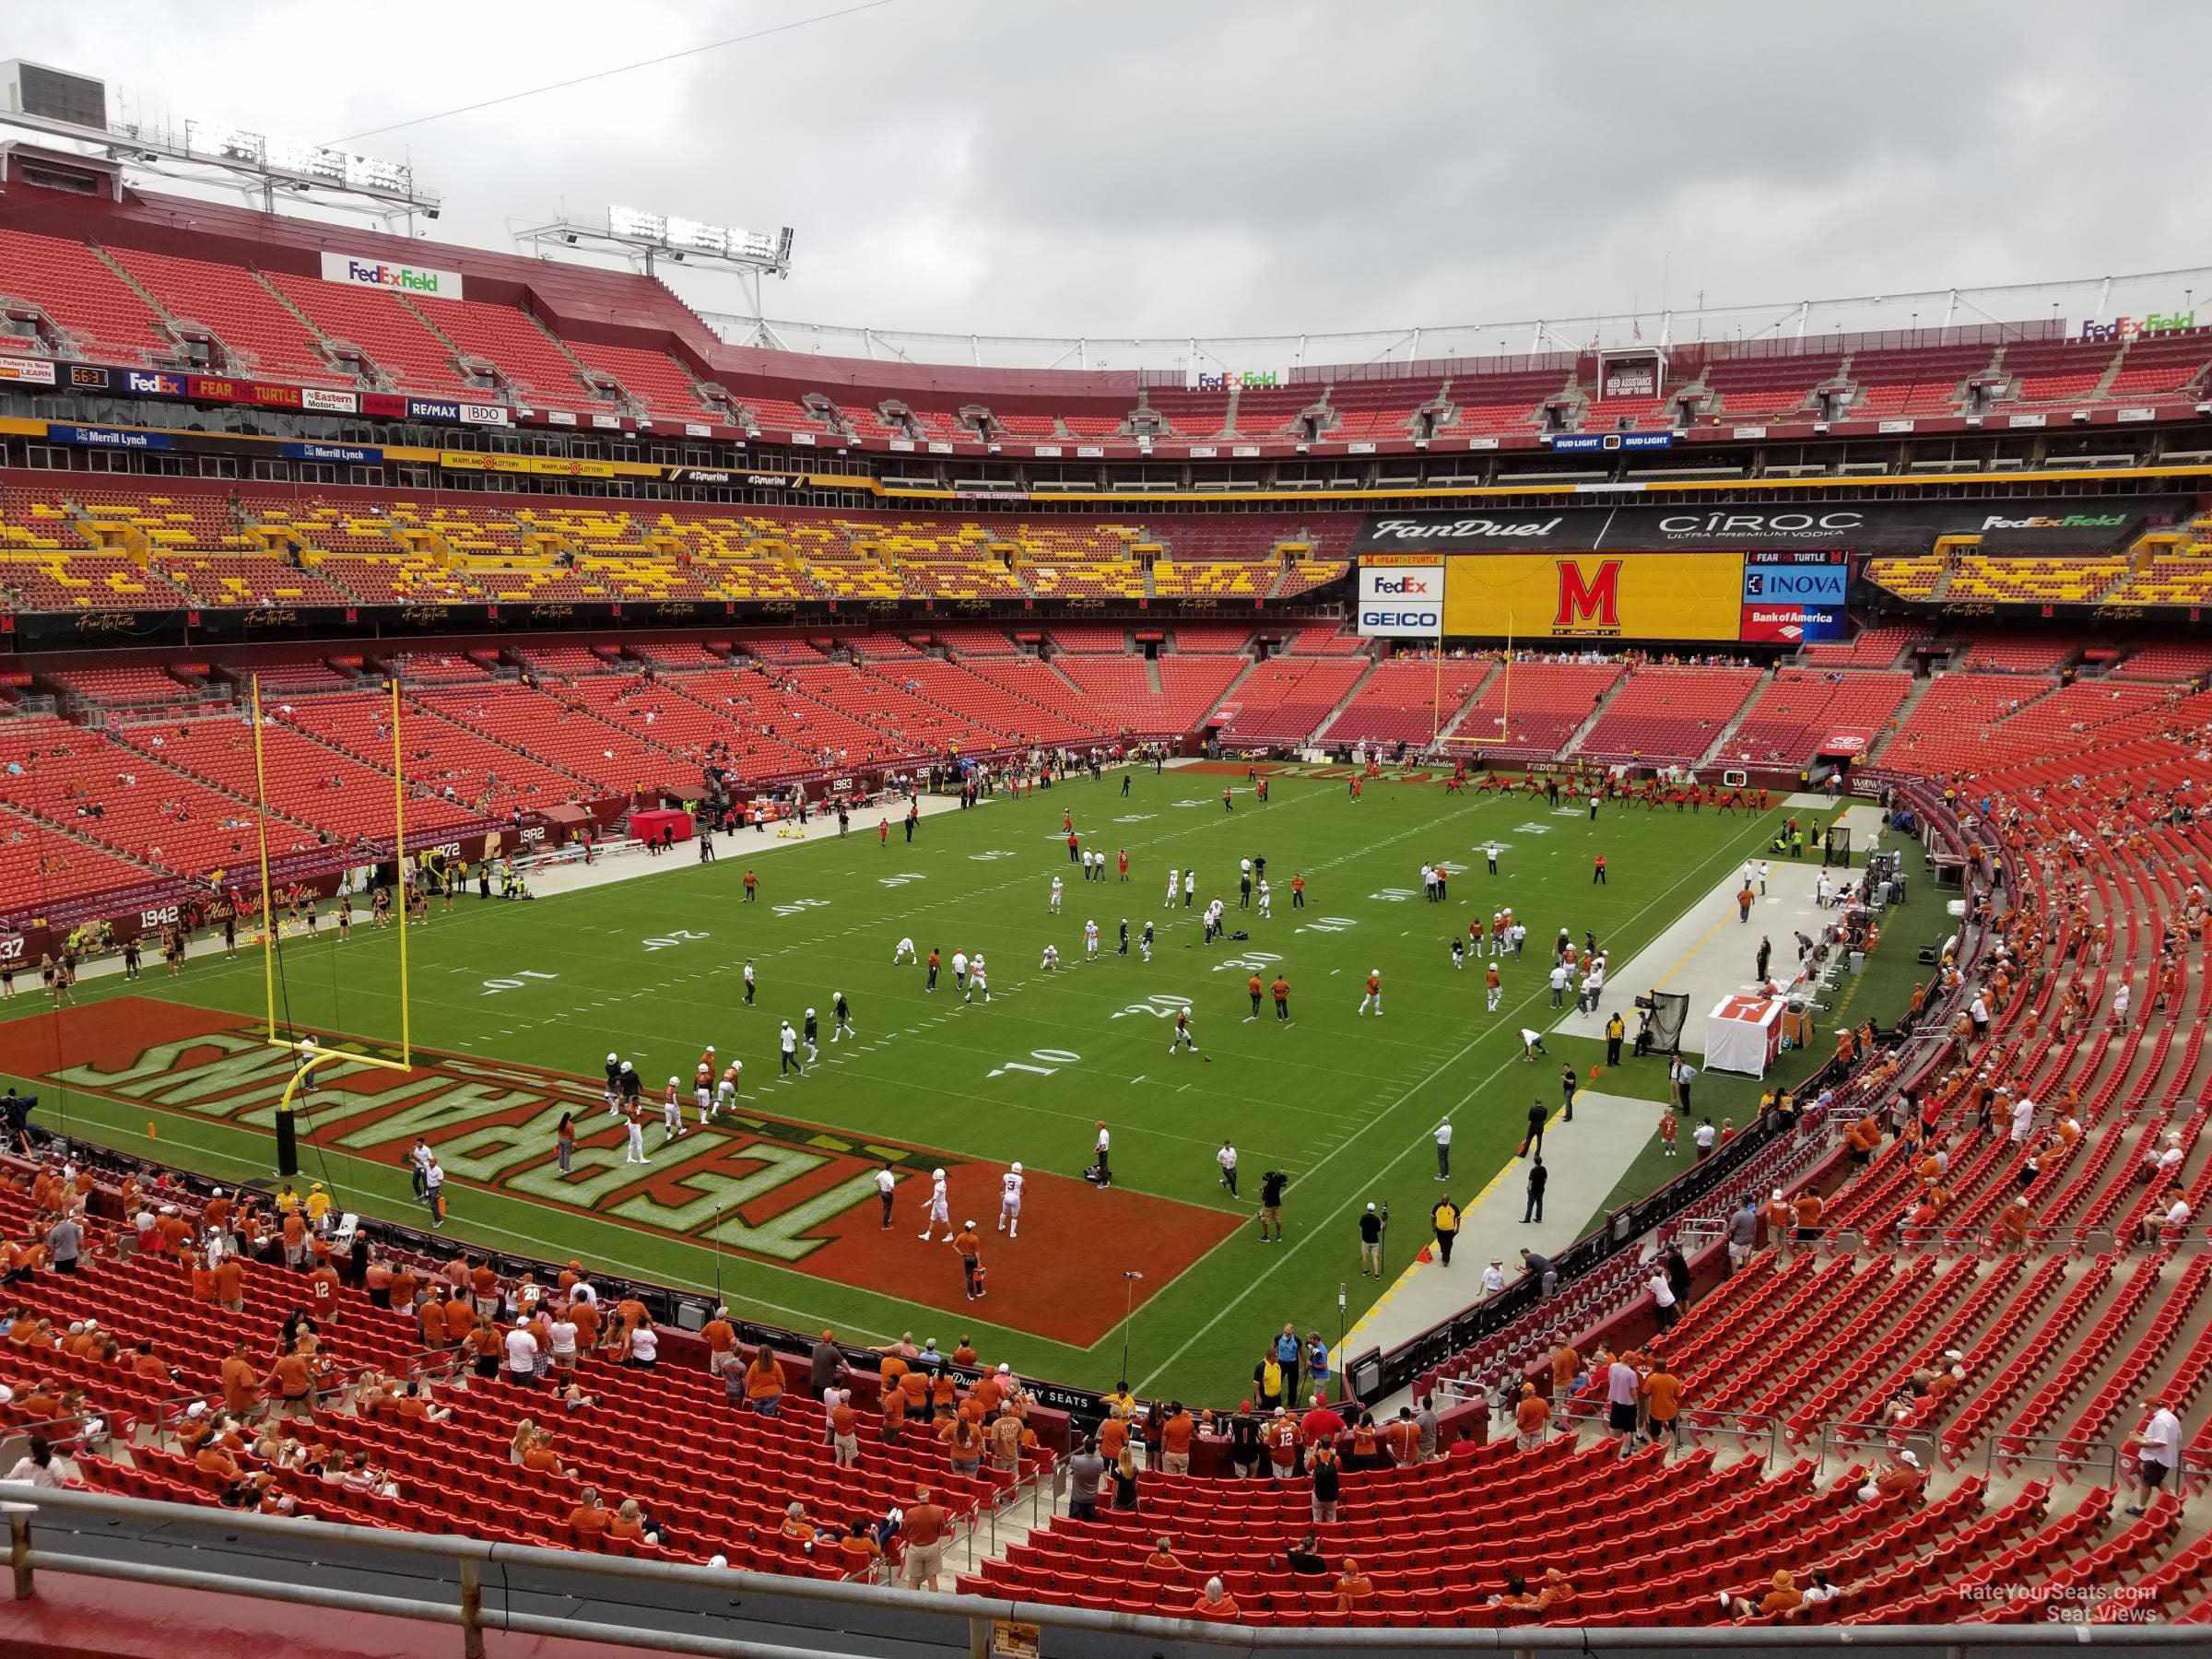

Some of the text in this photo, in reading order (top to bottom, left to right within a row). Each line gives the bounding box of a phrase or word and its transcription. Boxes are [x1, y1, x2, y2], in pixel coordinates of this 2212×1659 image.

[349, 261, 438, 292] FedExField
[2083, 310, 2195, 337] FedExField
[21, 369, 52, 378] LEARN
[1199, 371, 1277, 387] FedExField
[1621, 376, 1653, 387] ASSISTANCE
[130, 372, 179, 394] FedEx
[314, 391, 352, 404] Eastern
[412, 403, 456, 418] RE/MAX
[472, 406, 499, 419] BDO
[89, 430, 147, 445] Merrill Lynch
[1557, 439, 1598, 448] BUD LIGHT
[1643, 437, 1668, 445] LIGHT
[315, 448, 364, 460] Merrill Lynch
[541, 463, 570, 471] MARYLAND
[1372, 517, 1563, 539] FanDuel
[1659, 512, 1863, 532] CÎROC
[1983, 514, 2126, 530] FedExField
[1374, 576, 1427, 594] FedEx
[1553, 559, 1623, 626] M
[1771, 576, 1842, 594] INOVA
[1363, 612, 1438, 627] GEICO
[1753, 612, 1832, 623] Bank of America
[833, 779, 853, 791] 1983
[520, 827, 545, 843] 1982
[1368, 888, 1418, 901] 50
[771, 899, 830, 914] 30
[141, 906, 179, 929] 1942
[1316, 917, 1357, 934] 40
[642, 929, 711, 948] 20
[0, 938, 24, 959] 37
[1221, 951, 1284, 971] 30
[483, 970, 560, 991] 10
[1124, 994, 1194, 1019] 20
[1003, 1049, 1081, 1077] 10
[42, 1032, 886, 1261] TERRAPINS
[1007, 1181, 1016, 1191] 3
[314, 1281, 330, 1298] 12
[524, 1288, 540, 1301] 20
[1049, 1392, 1088, 1408] SEATS
[1279, 1433, 1293, 1447] 12
